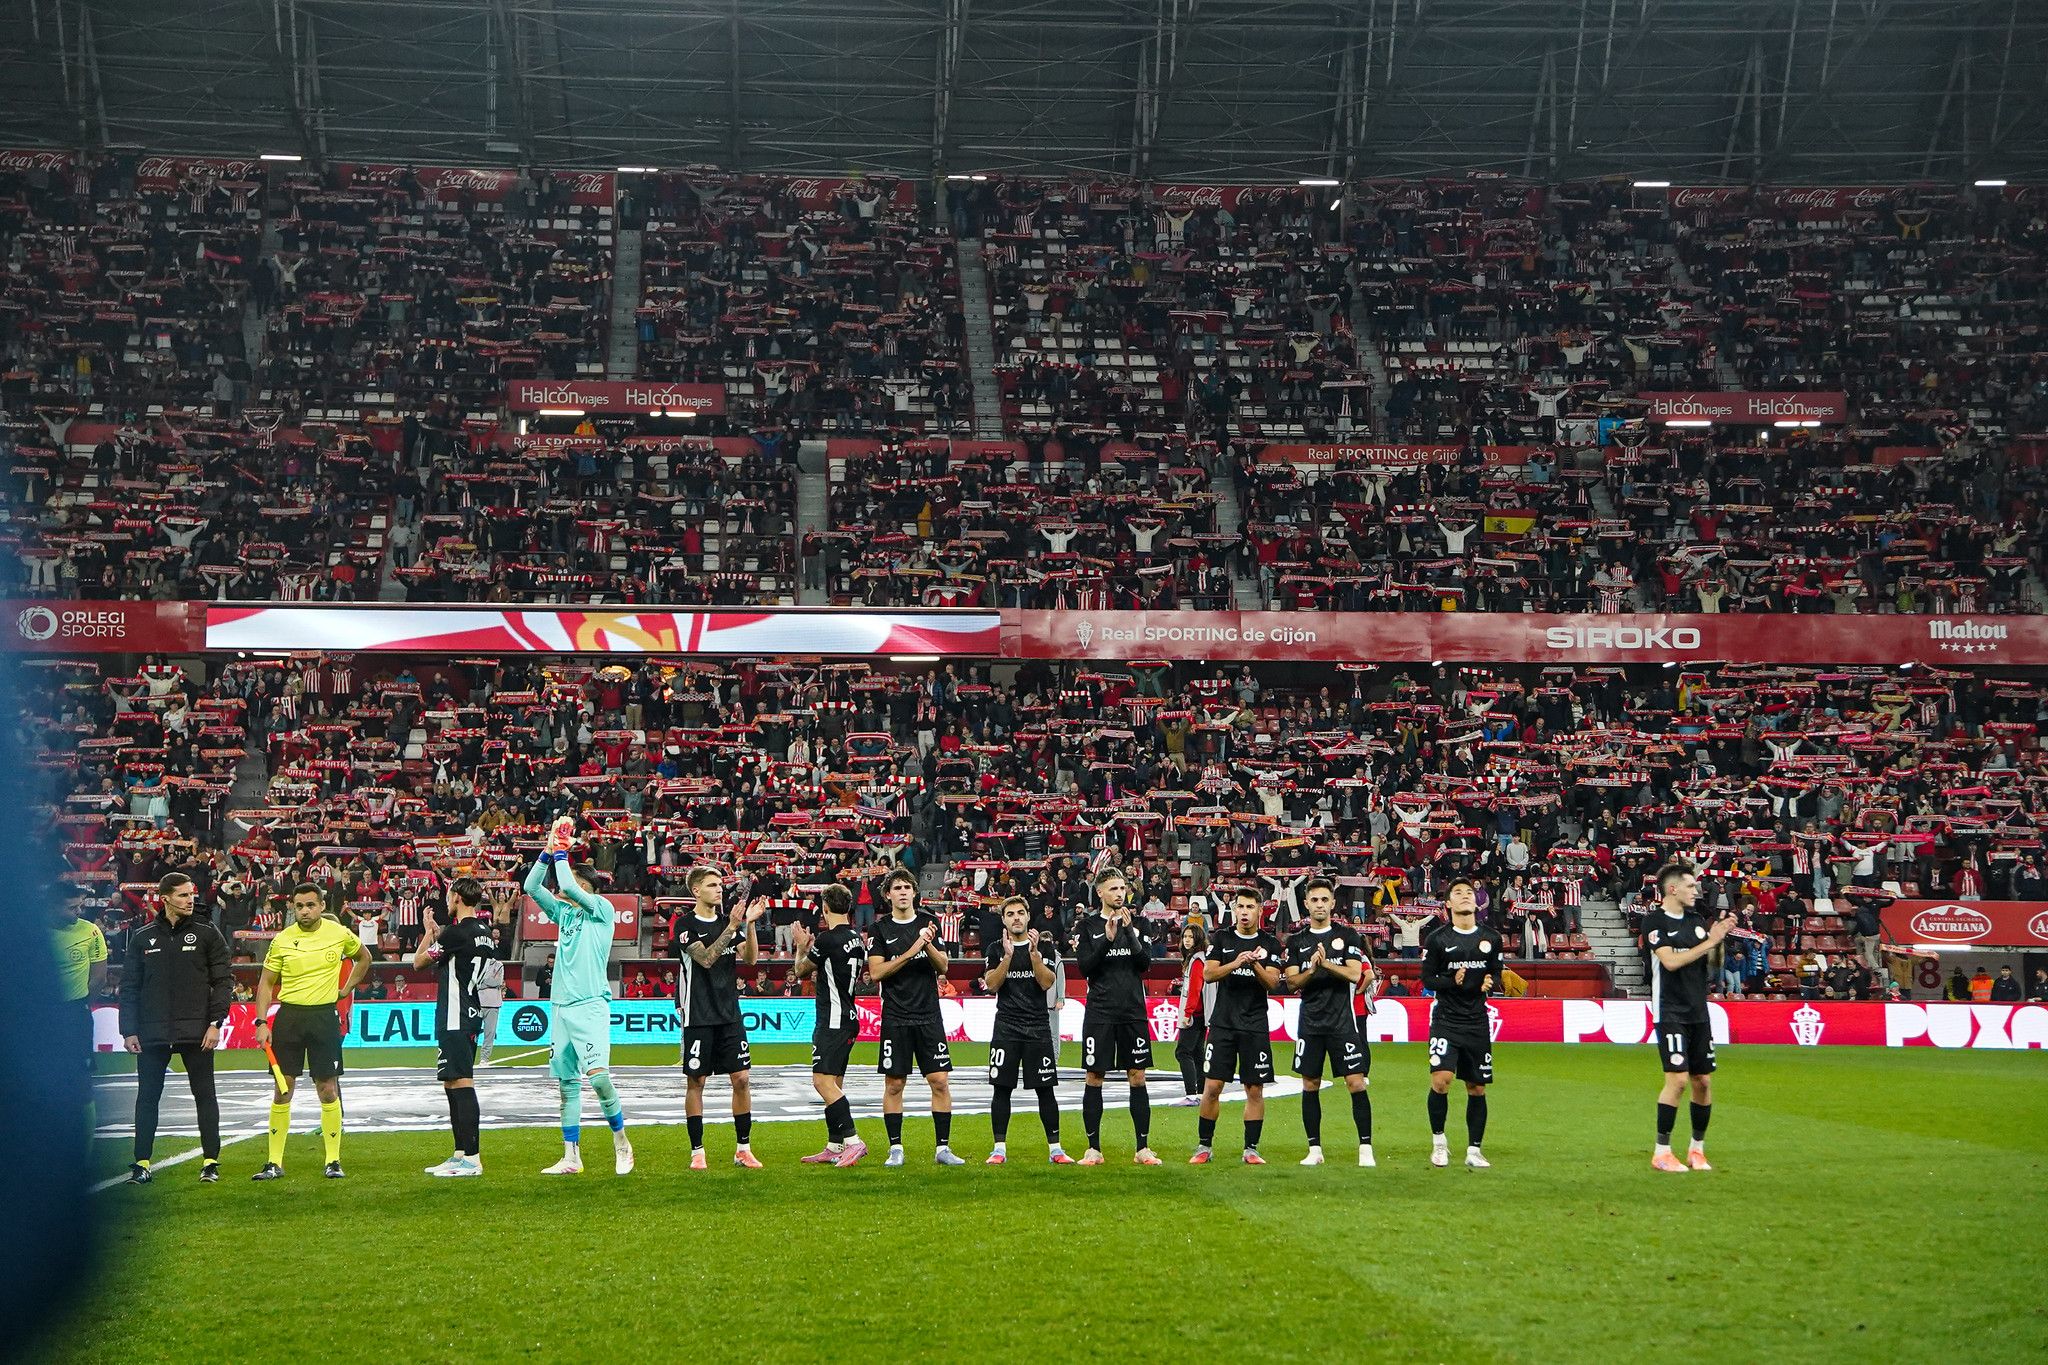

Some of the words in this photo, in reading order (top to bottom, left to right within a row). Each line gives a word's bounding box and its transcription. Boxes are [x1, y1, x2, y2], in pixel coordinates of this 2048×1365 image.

[521, 383, 578, 404] Halcón
[578, 394, 609, 407] viajes
[626, 383, 682, 407] Halcón
[682, 397, 712, 409] viajes
[1702, 404, 1732, 417] viajes
[1749, 394, 1803, 415] Halcón
[1804, 404, 1834, 418] viajes
[1308, 448, 1333, 460] Real
[1338, 449, 1408, 461] SPORTING
[1412, 448, 1428, 460] de
[61, 611, 125, 624] ORLEGI
[61, 624, 125, 637] SPORTS
[1101, 627, 1139, 641] Real
[1145, 627, 1238, 642] SPORTING
[1243, 627, 1265, 641] de
[1270, 626, 1316, 645] Gijón
[1546, 627, 1701, 649] SIROKO
[1929, 619, 2008, 640] Mahou
[926, 873, 932, 881] 9
[1601, 929, 1607, 937] 6
[1917, 917, 1986, 932] ASTURIANA
[1618, 967, 1625, 975] 4
[1918, 956, 1942, 989] 8
[516, 1024, 544, 1032] SPORTS
[519, 1013, 539, 1024] EA
[1884, 1003, 2048, 1049] PUXA
[689, 1039, 702, 1058] 4
[883, 1039, 893, 1057] 5
[1086, 1036, 1096, 1055] 9
[1204, 1043, 1214, 1062] 6
[1429, 1036, 1448, 1056] 29
[1665, 1033, 1684, 1053] 11
[990, 1048, 1005, 1067] 20
